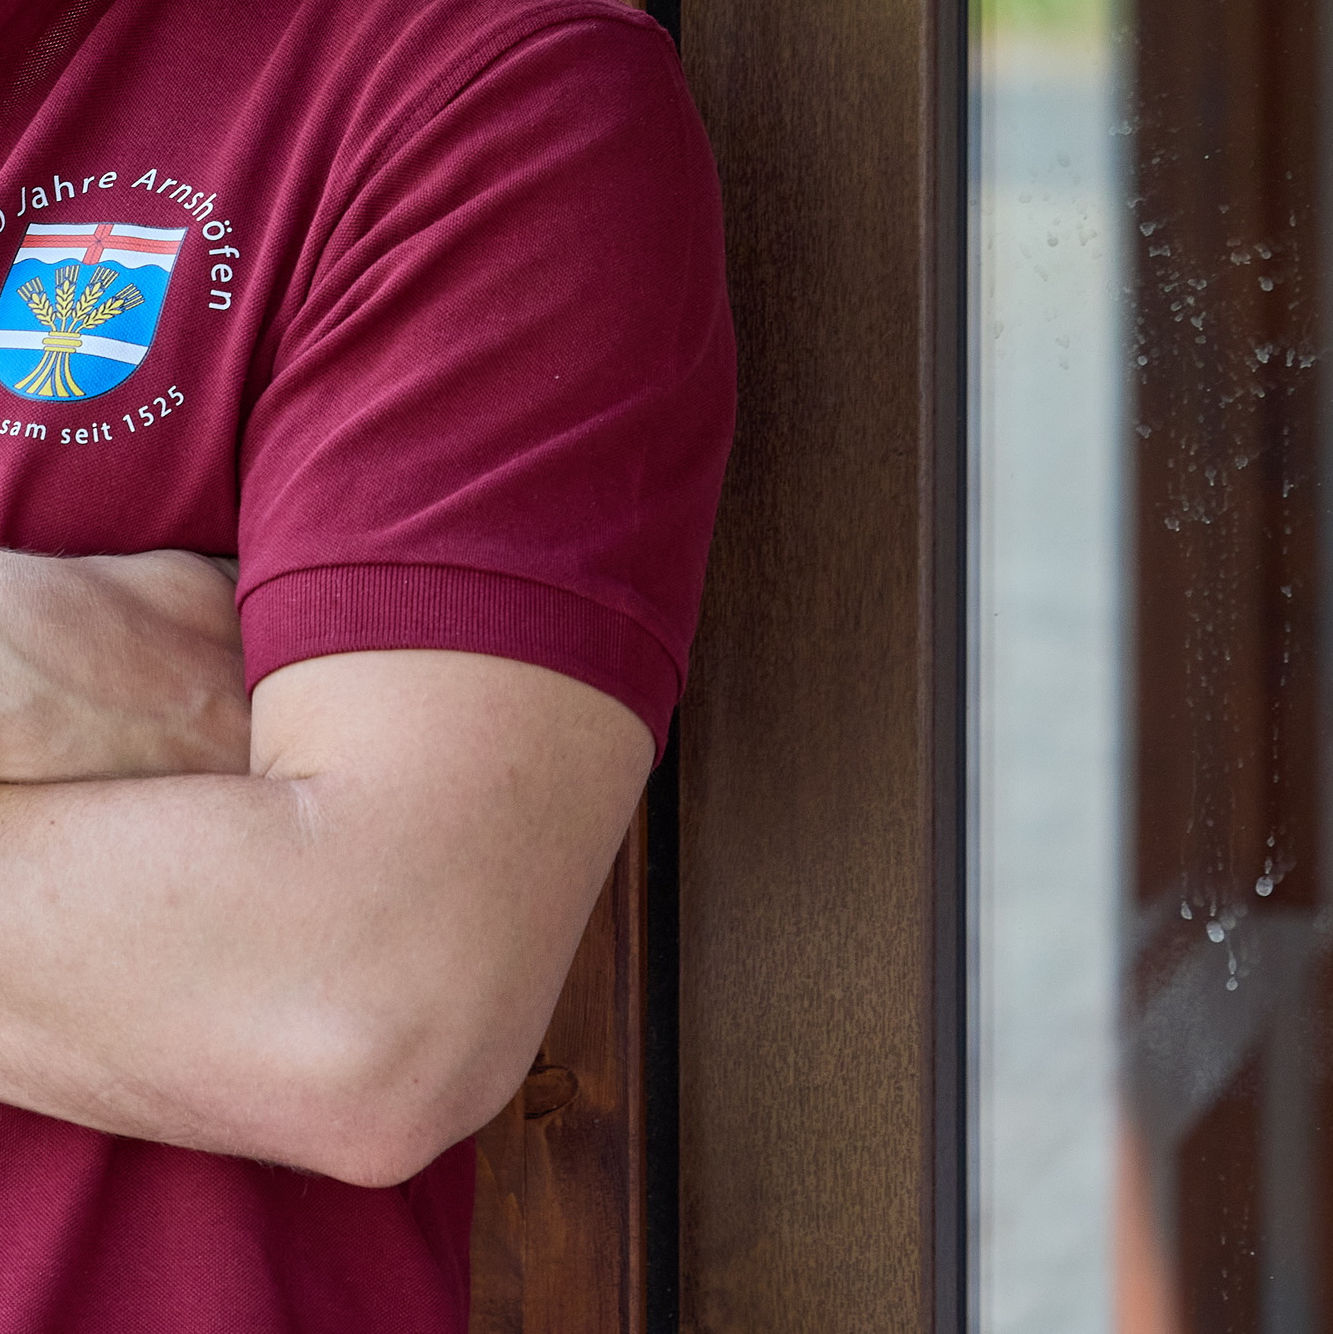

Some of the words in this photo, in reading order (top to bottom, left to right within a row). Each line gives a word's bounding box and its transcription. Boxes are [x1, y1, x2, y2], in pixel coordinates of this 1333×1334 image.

[18, 172, 117, 216] Jahre
[131, 169, 239, 310] Arnshöfen
[61, 423, 112, 444] seit
[123, 386, 184, 432] 1525
